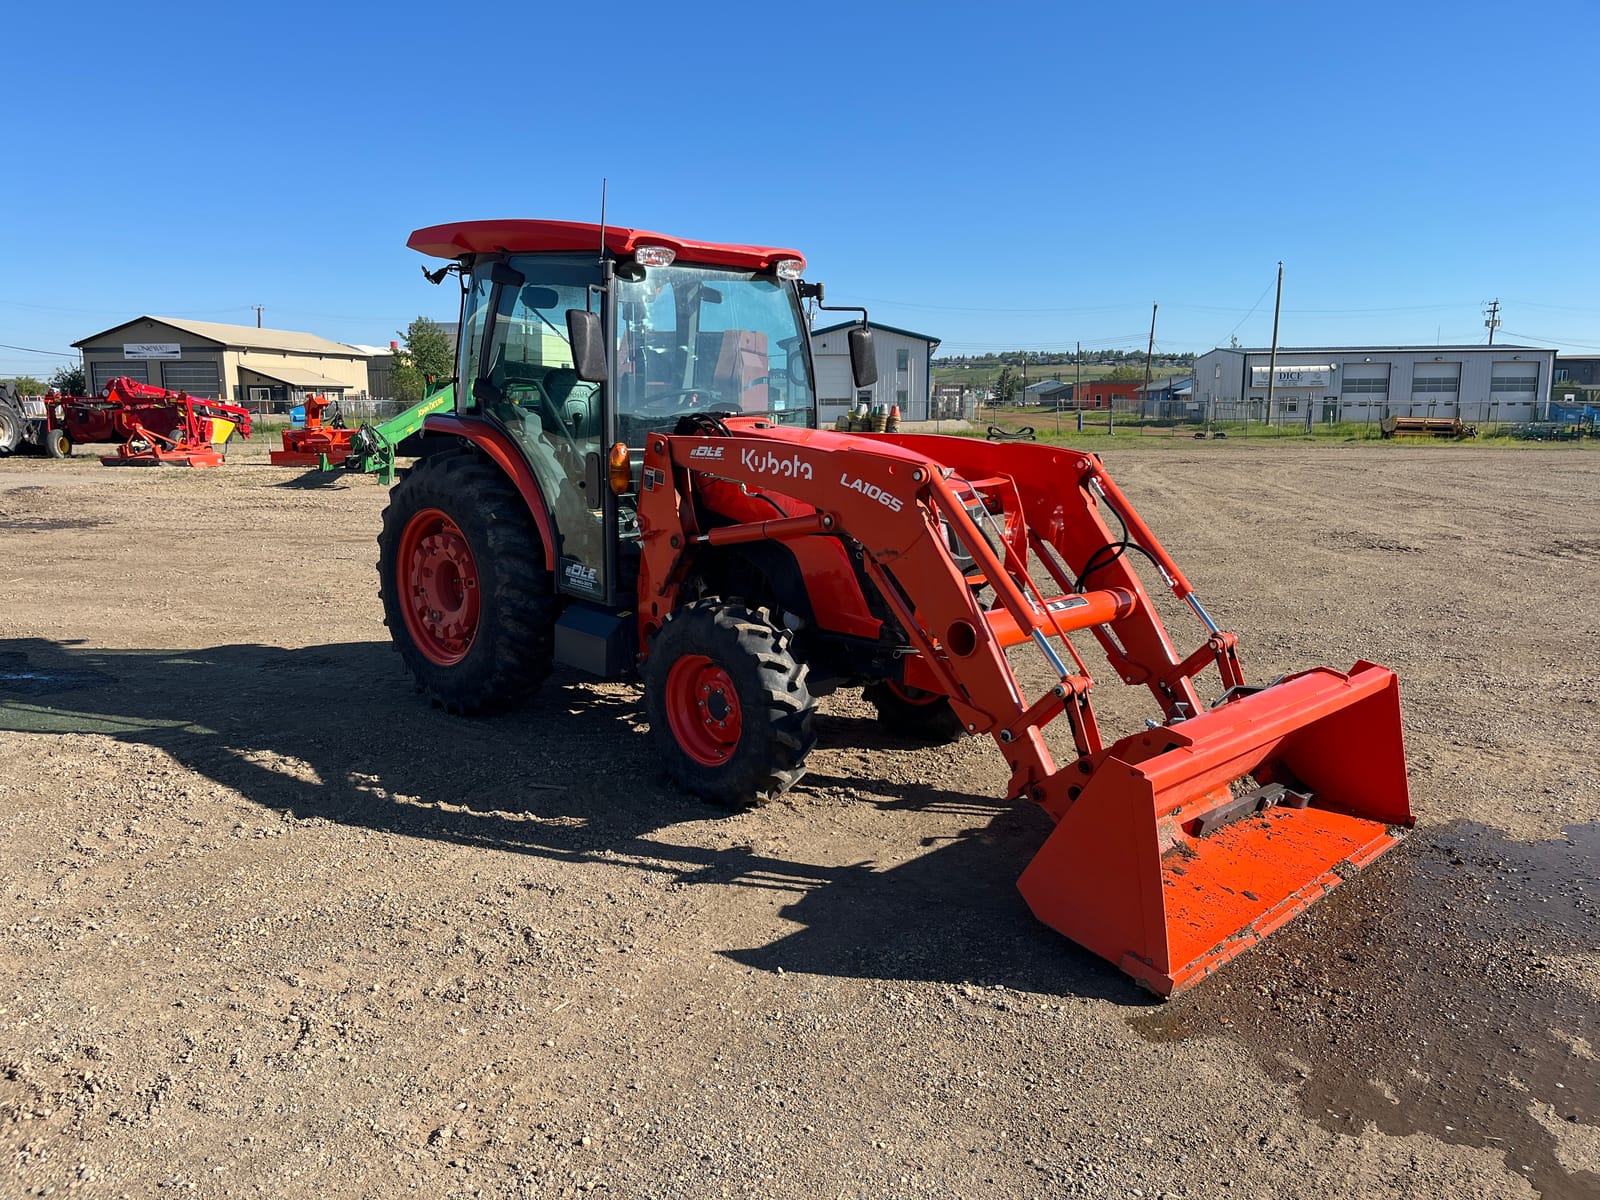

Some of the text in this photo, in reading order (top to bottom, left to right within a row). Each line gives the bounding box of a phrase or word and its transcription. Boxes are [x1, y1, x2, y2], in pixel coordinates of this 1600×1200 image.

[1279, 372, 1303, 380] DICE
[741, 447, 813, 480] Kubota
[840, 473, 904, 512] LA1065
